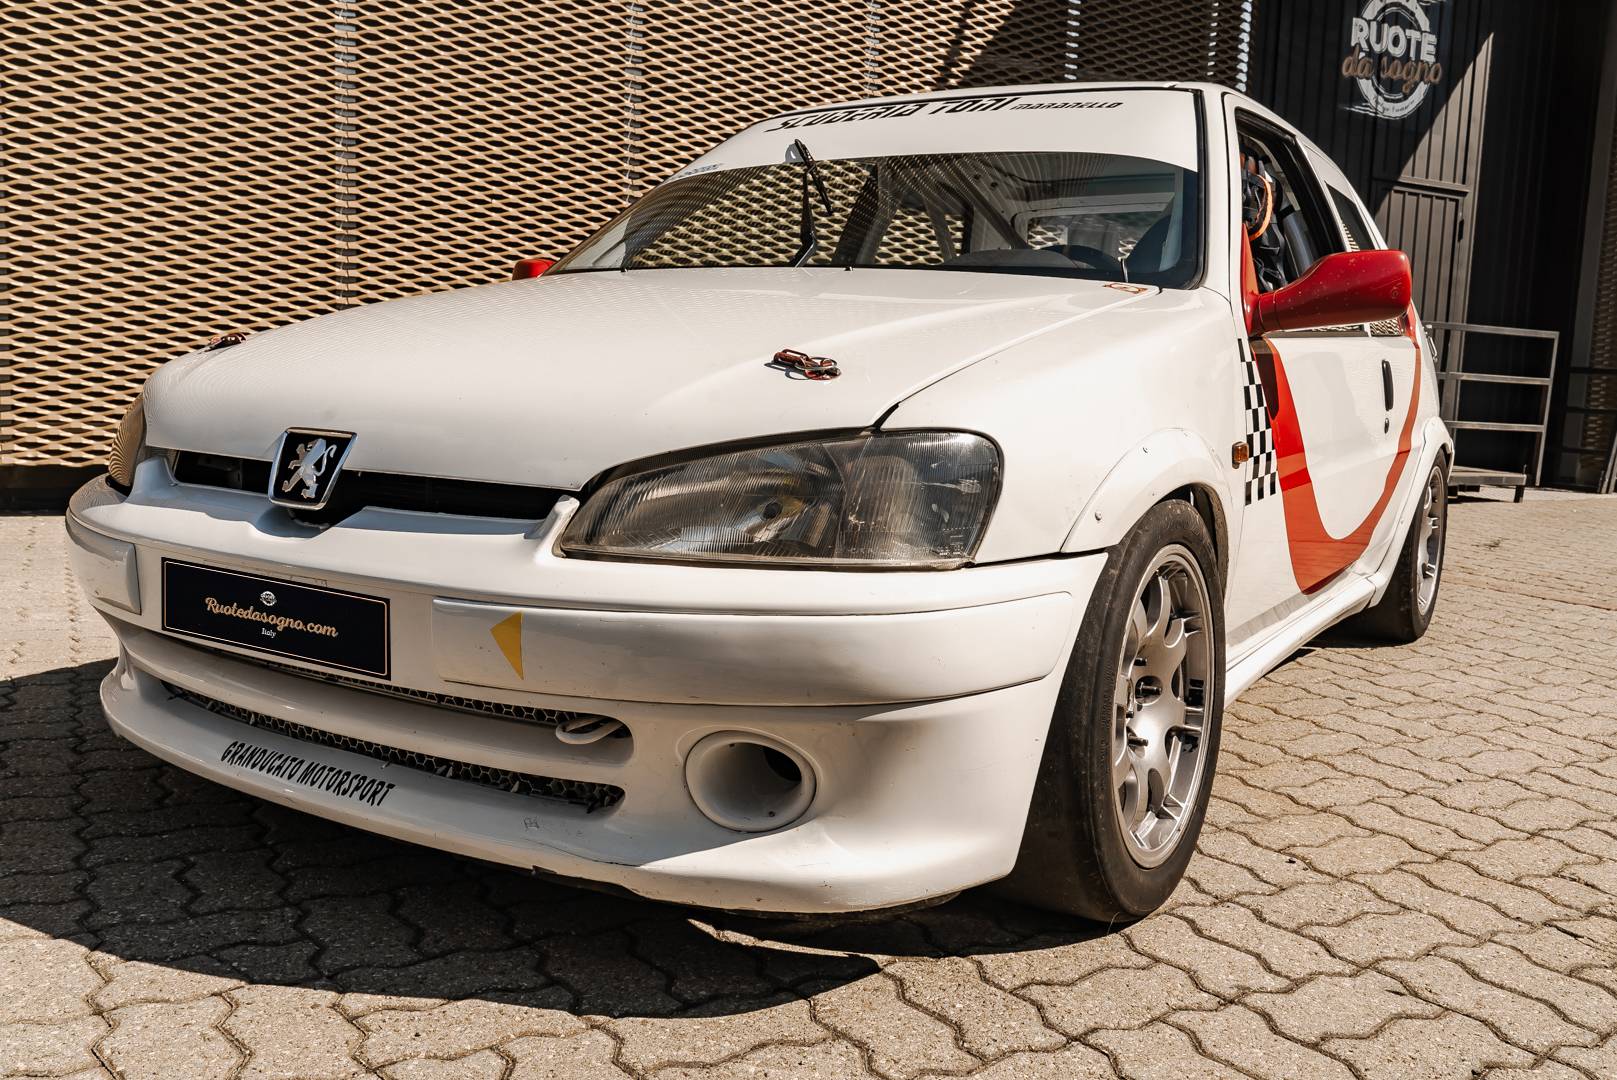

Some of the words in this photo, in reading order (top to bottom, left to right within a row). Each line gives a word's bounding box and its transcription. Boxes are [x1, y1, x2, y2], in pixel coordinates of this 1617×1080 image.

[1351, 17, 1437, 64] RUOTE
[1342, 44, 1374, 79] da
[1380, 55, 1442, 95] sogno
[763, 103, 930, 133] SCUDERIA
[204, 596, 339, 638] Ruotedasogno.com
[261, 627, 277, 639] Italy
[220, 740, 302, 781] GRANDUCATO
[296, 761, 396, 808] MOTORSPORT
